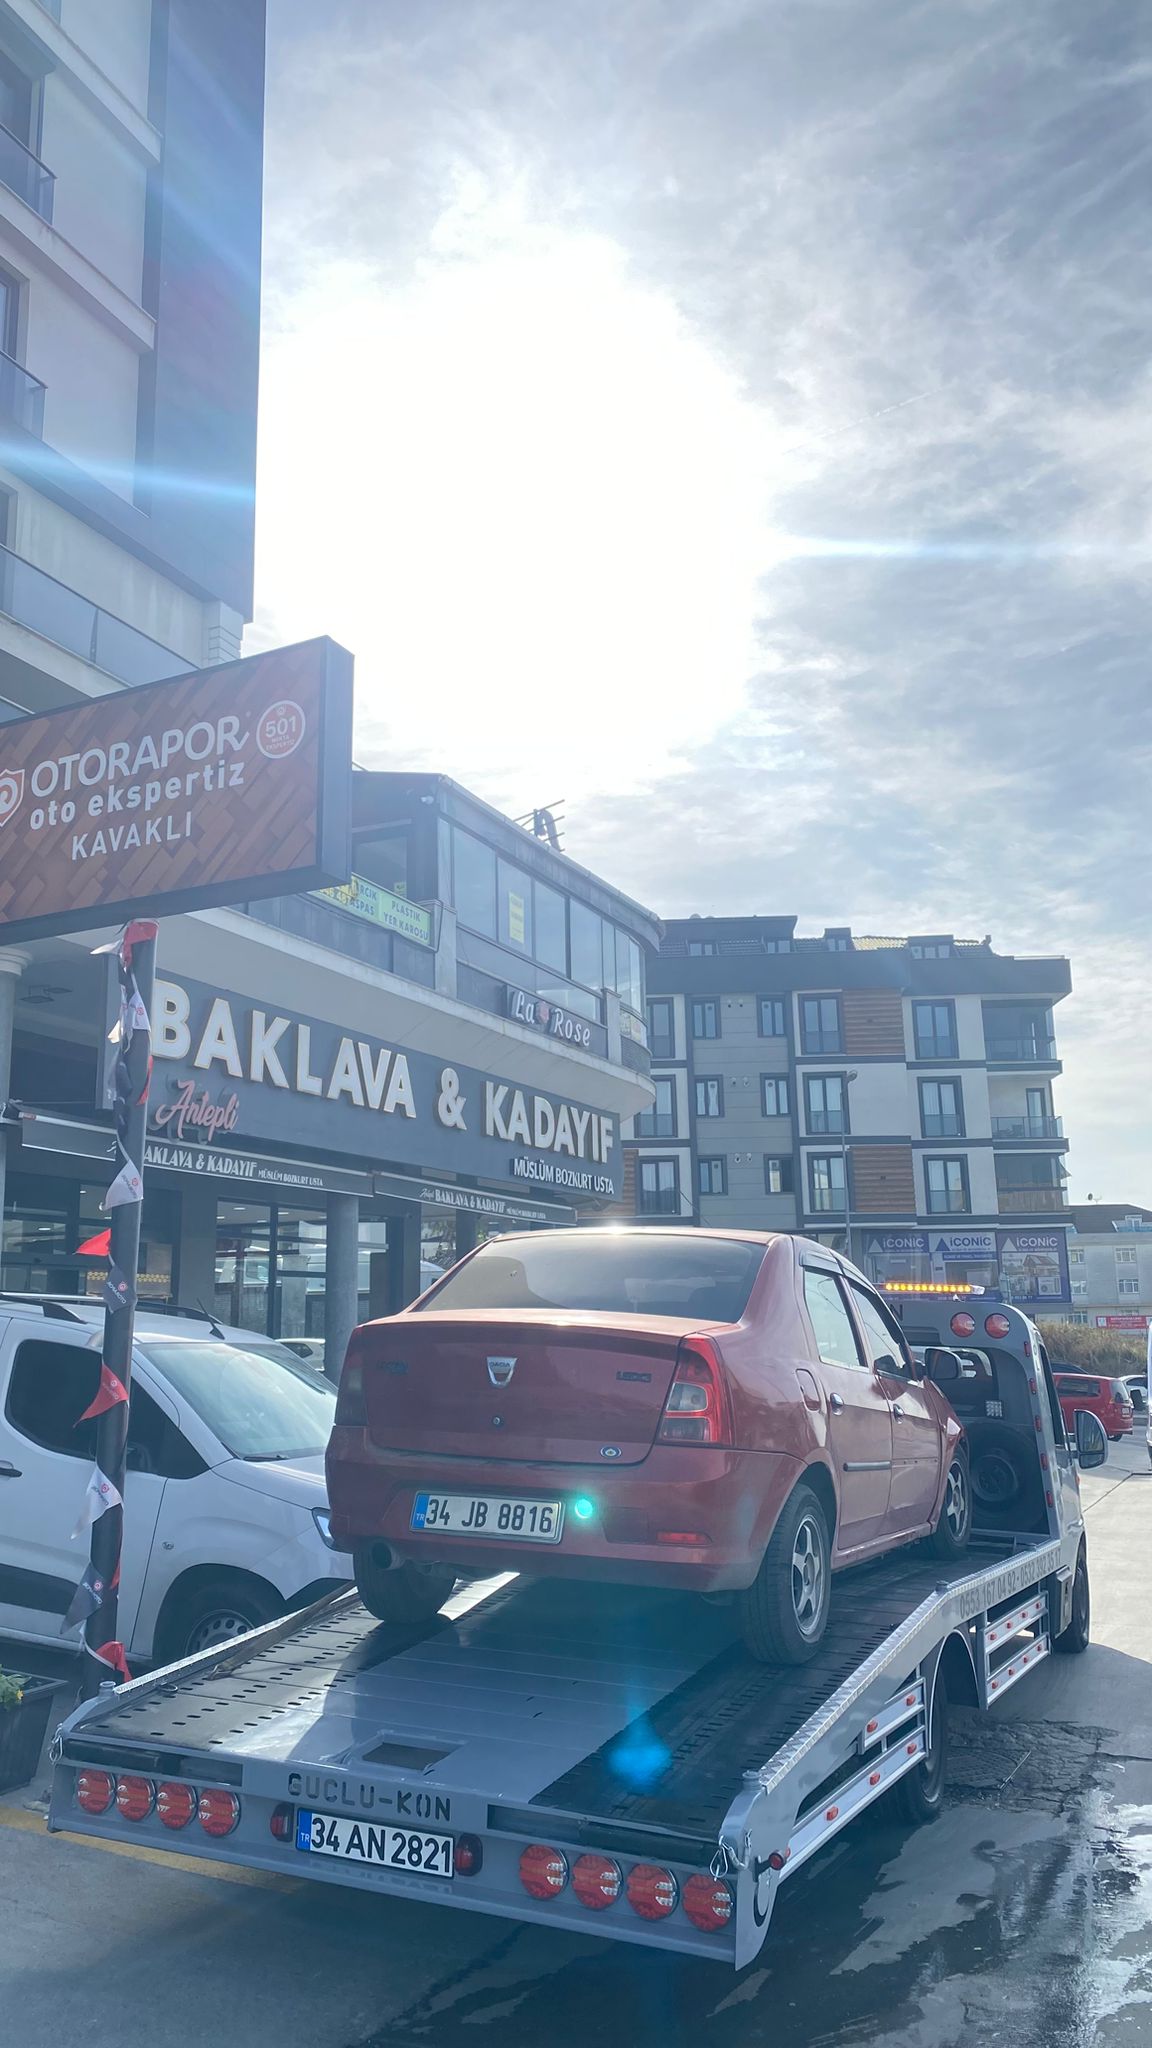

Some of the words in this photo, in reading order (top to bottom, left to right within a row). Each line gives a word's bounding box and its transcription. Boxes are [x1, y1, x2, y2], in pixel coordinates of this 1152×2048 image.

[265, 716, 296, 737] 501
[31, 716, 249, 797] OTORAPOR
[30, 797, 76, 830] oto
[88, 759, 245, 817] ekspertiz
[71, 811, 192, 861] KAVAKLI
[515, 991, 535, 1024] La
[554, 1008, 591, 1046] Rose
[154, 979, 417, 1118] BAKLAVA
[438, 1067, 467, 1130] &
[485, 1080, 613, 1163] KADAYIF
[155, 1080, 239, 1141] Antepli
[144, 1145, 192, 1169] AKLAVA
[197, 1154, 204, 1170] &
[206, 1154, 258, 1177] KADAYIF
[514, 1156, 553, 1182] MÜSLÜM
[556, 1168, 592, 1189] BOZKURT
[594, 1176, 615, 1194] USTA
[416, 1513, 425, 1521] TR
[426, 1499, 450, 1526] 34
[461, 1502, 488, 1528] JB
[497, 1504, 553, 1533] 8816
[301, 1834, 310, 1842] TR
[311, 1817, 340, 1852] 34
[345, 1825, 385, 1861] AN
[391, 1832, 450, 1873] 2821
